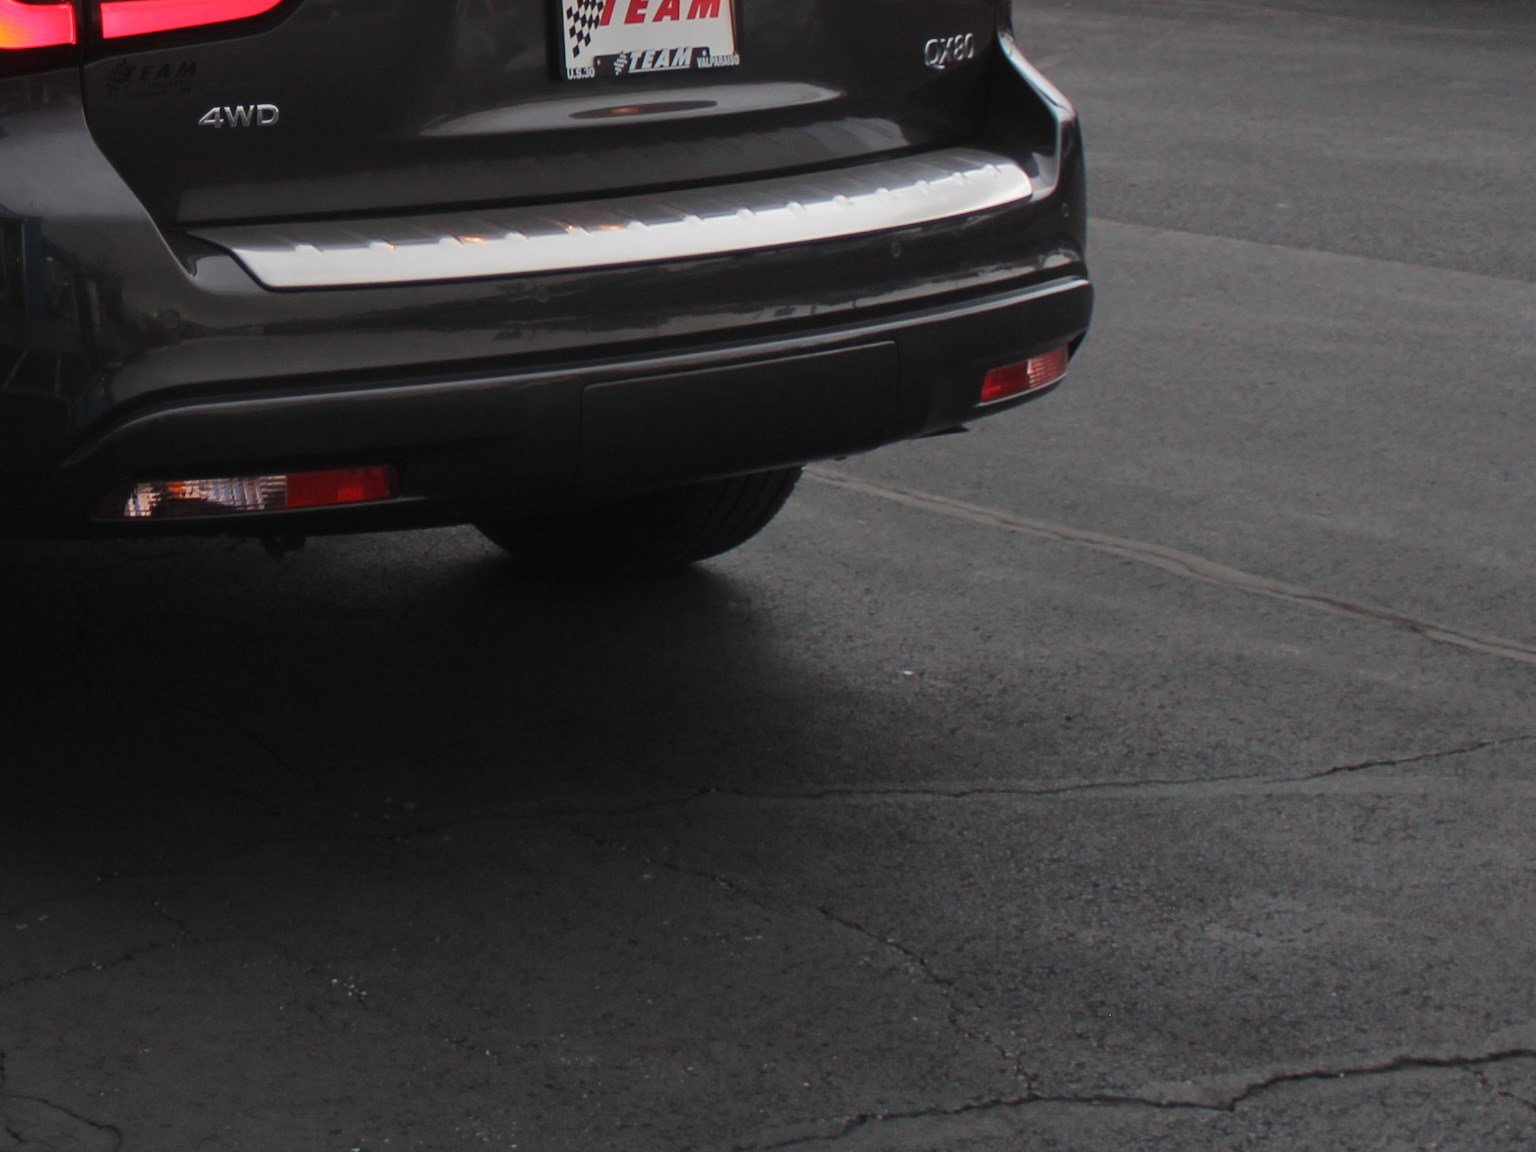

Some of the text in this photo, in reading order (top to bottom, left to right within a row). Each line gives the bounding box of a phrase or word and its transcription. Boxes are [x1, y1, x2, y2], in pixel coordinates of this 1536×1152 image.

[628, 47, 694, 70] TEAM
[123, 61, 198, 82] TEAM
[197, 103, 280, 129] 4WD
